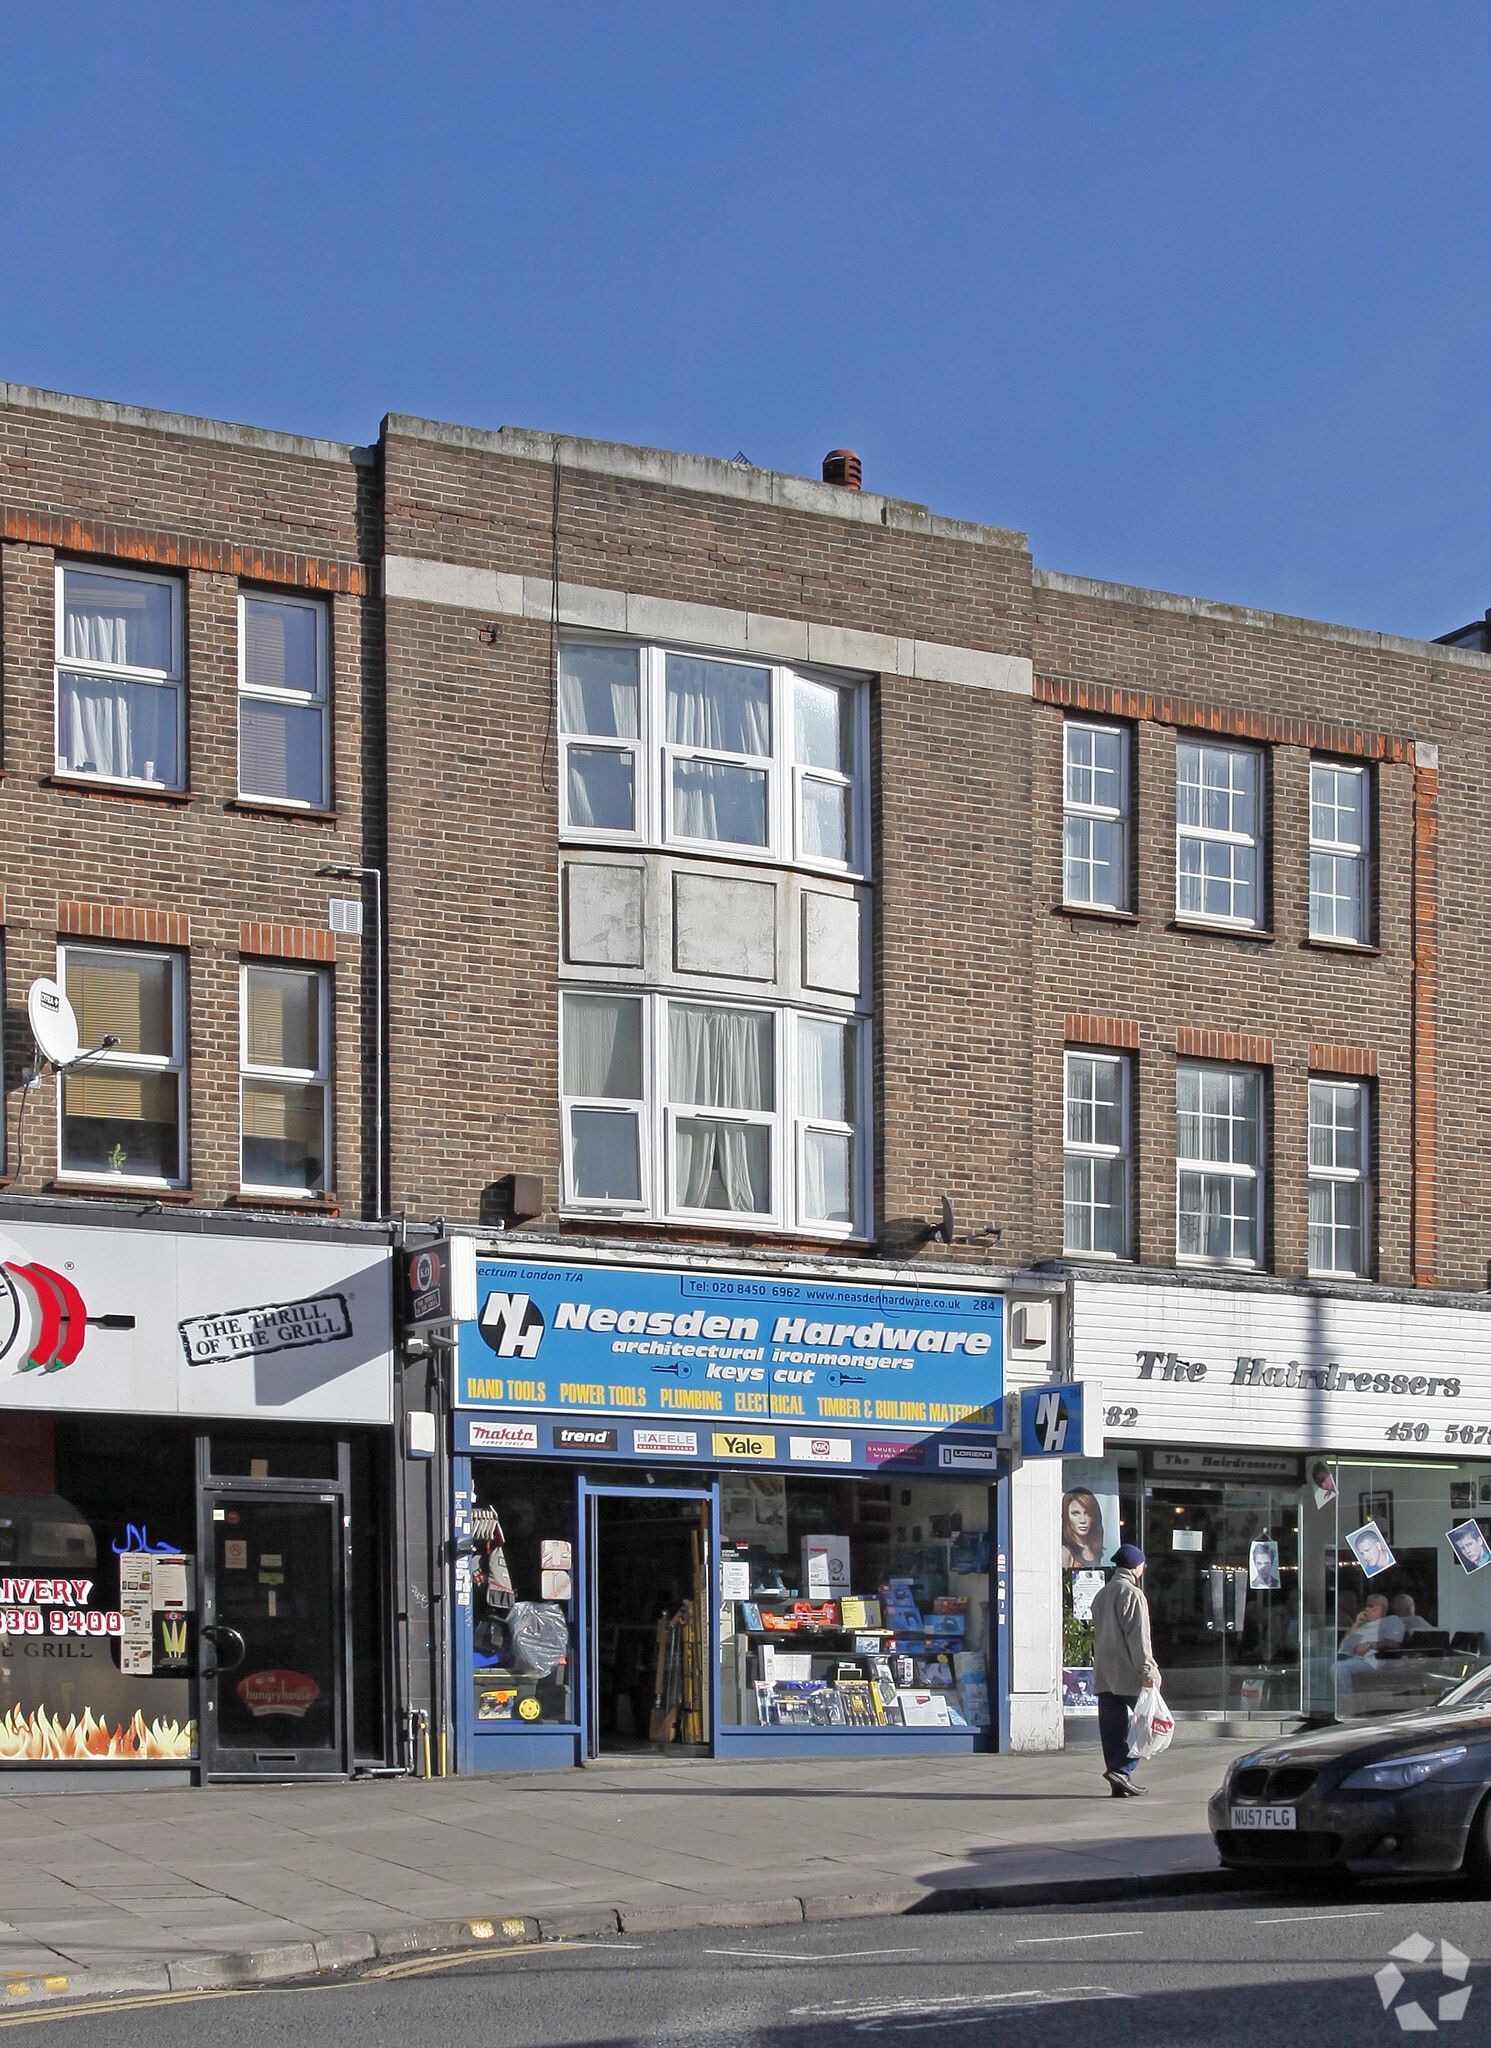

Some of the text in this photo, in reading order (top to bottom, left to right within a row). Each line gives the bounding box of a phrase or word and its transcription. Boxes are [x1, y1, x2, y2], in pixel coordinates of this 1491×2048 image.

[520, 1269, 562, 1281] London
[565, 1272, 584, 1283] T/A
[689, 1280, 961, 1310] Tel: 020 8450 6962 www.neasdenhardware.co.uk
[972, 1299, 995, 1312] 284
[198, 1304, 327, 1338] THE THRILL
[552, 1302, 993, 1357] Neasden Hardware
[195, 1318, 341, 1356] OF THE GRILL
[611, 1340, 915, 1370] architectural ironmongers
[705, 1362, 816, 1385] keys cut
[1136, 1350, 1461, 1398] The Hairdressers
[467, 1378, 547, 1402] HAND TOOLS
[560, 1383, 646, 1407] POWER TOOLS
[660, 1388, 723, 1411] PLUMBING
[735, 1392, 805, 1415] ELECTRICAL
[817, 1396, 995, 1425] TIMBER & BUILDING MATERIALS
[1103, 1405, 1139, 1428] 82
[561, 1429, 608, 1443] trend
[637, 1433, 695, 1444] HÄFELE
[1384, 1421, 1430, 1442] 450
[723, 1436, 763, 1454] Yale
[954, 1450, 991, 1458] LORIENT
[1164, 1454, 1287, 1470] The Hairdressers
[0, 1610, 44, 1635] 30
[49, 1610, 125, 1636] 9400
[23, 1642, 93, 1659] GRILL
[246, 1679, 313, 1703] hungryhouse
[1234, 1809, 1290, 1827] NU57 FLG
